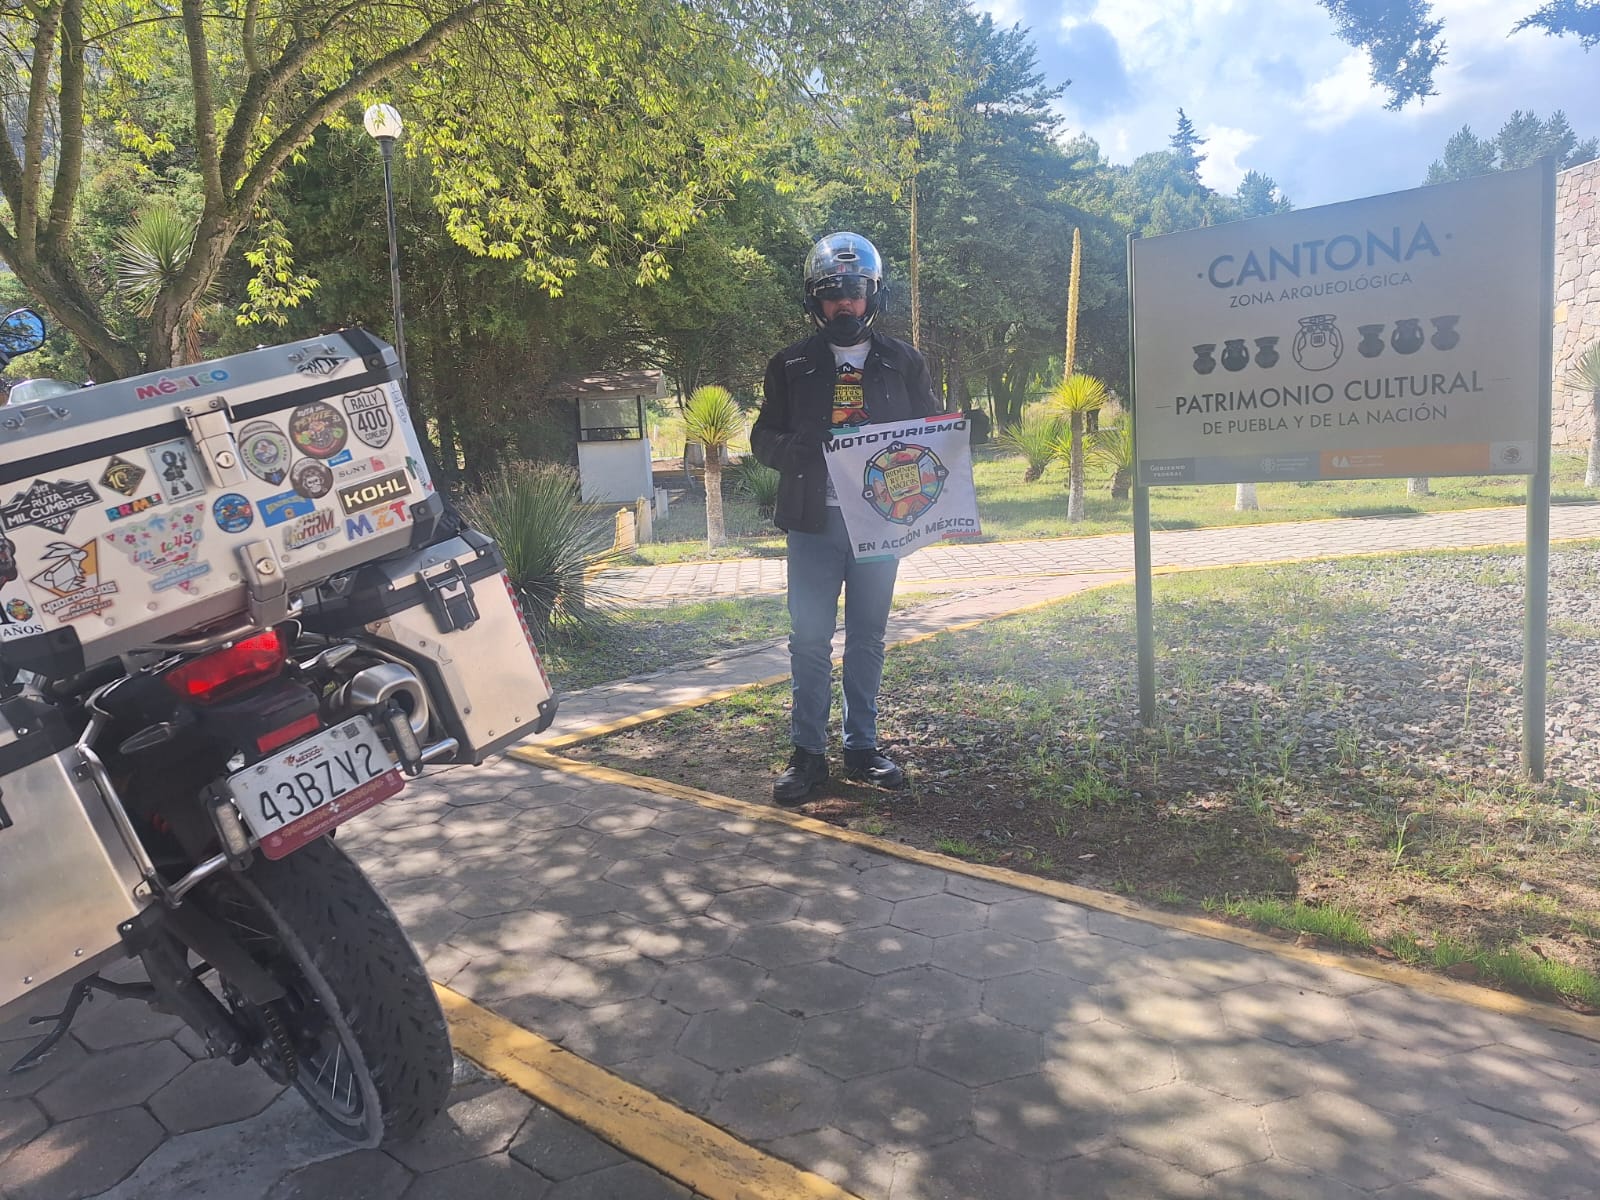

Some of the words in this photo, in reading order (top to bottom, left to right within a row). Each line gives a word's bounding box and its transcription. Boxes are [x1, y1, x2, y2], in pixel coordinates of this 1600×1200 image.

[1207, 220, 1441, 289] CANTONA
[1229, 291, 1275, 309] ZONA
[1279, 272, 1413, 301] ARQUEOLÓGICA
[350, 393, 378, 411] RALLY
[1175, 383, 1334, 415] PATRIMONIO
[1344, 370, 1484, 402] CULTURAL
[358, 408, 388, 433] 400
[1203, 422, 1223, 436] DE
[1228, 418, 1289, 434] PUEBLA
[1293, 415, 1304, 429] Y
[1310, 414, 1332, 428] DE
[1338, 411, 1360, 426] LA
[1367, 402, 1448, 425] NACIÓN
[825, 420, 967, 453] MOTOTURISMO
[7, 513, 31, 527] MIL
[30, 492, 94, 519] CUMBRES
[31, 492, 63, 509] RUTA
[344, 478, 407, 508] KOHL
[44, 513, 71, 527] 2019
[858, 541, 876, 552] EN
[881, 529, 921, 550] ACCIÓN
[925, 517, 975, 535] MÉXICO
[3, 624, 44, 637] AÑOS
[259, 743, 384, 824] 43BZV2
